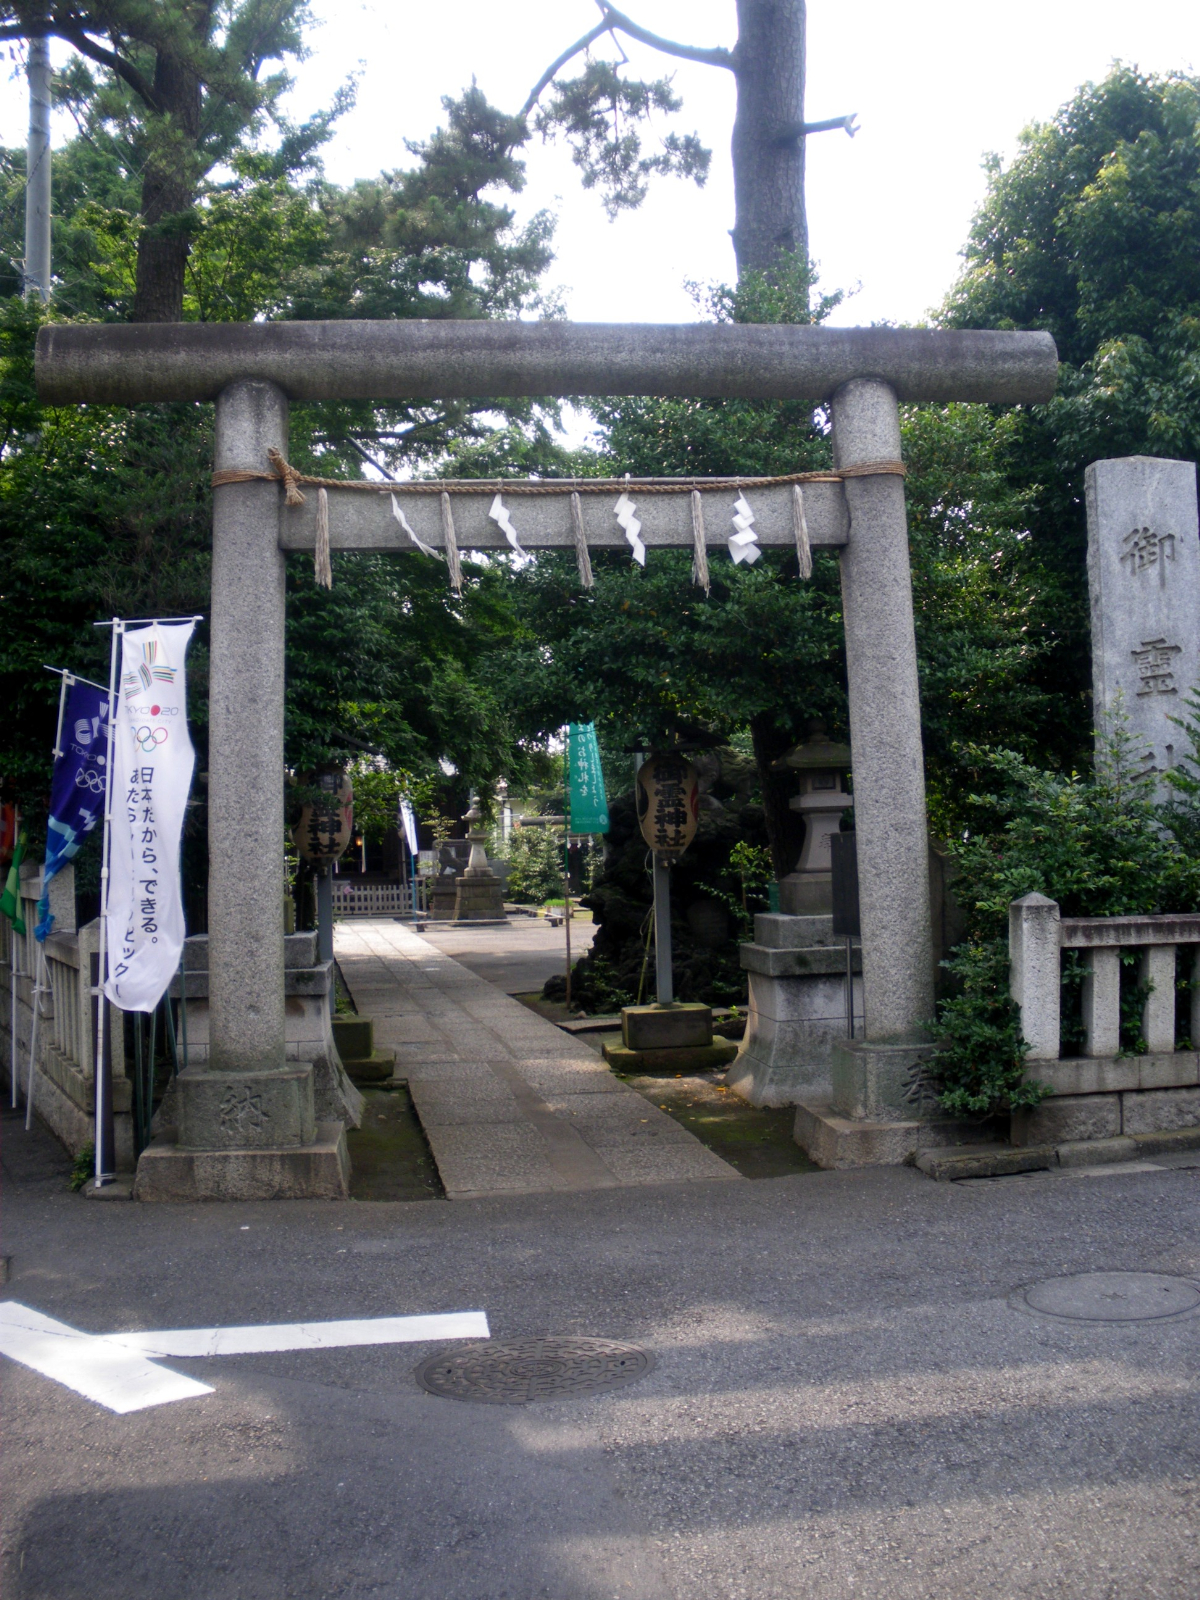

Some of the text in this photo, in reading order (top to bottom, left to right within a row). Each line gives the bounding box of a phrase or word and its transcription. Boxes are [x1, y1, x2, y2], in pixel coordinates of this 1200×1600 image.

[139, 766, 158, 944] 日本だから、できる。
